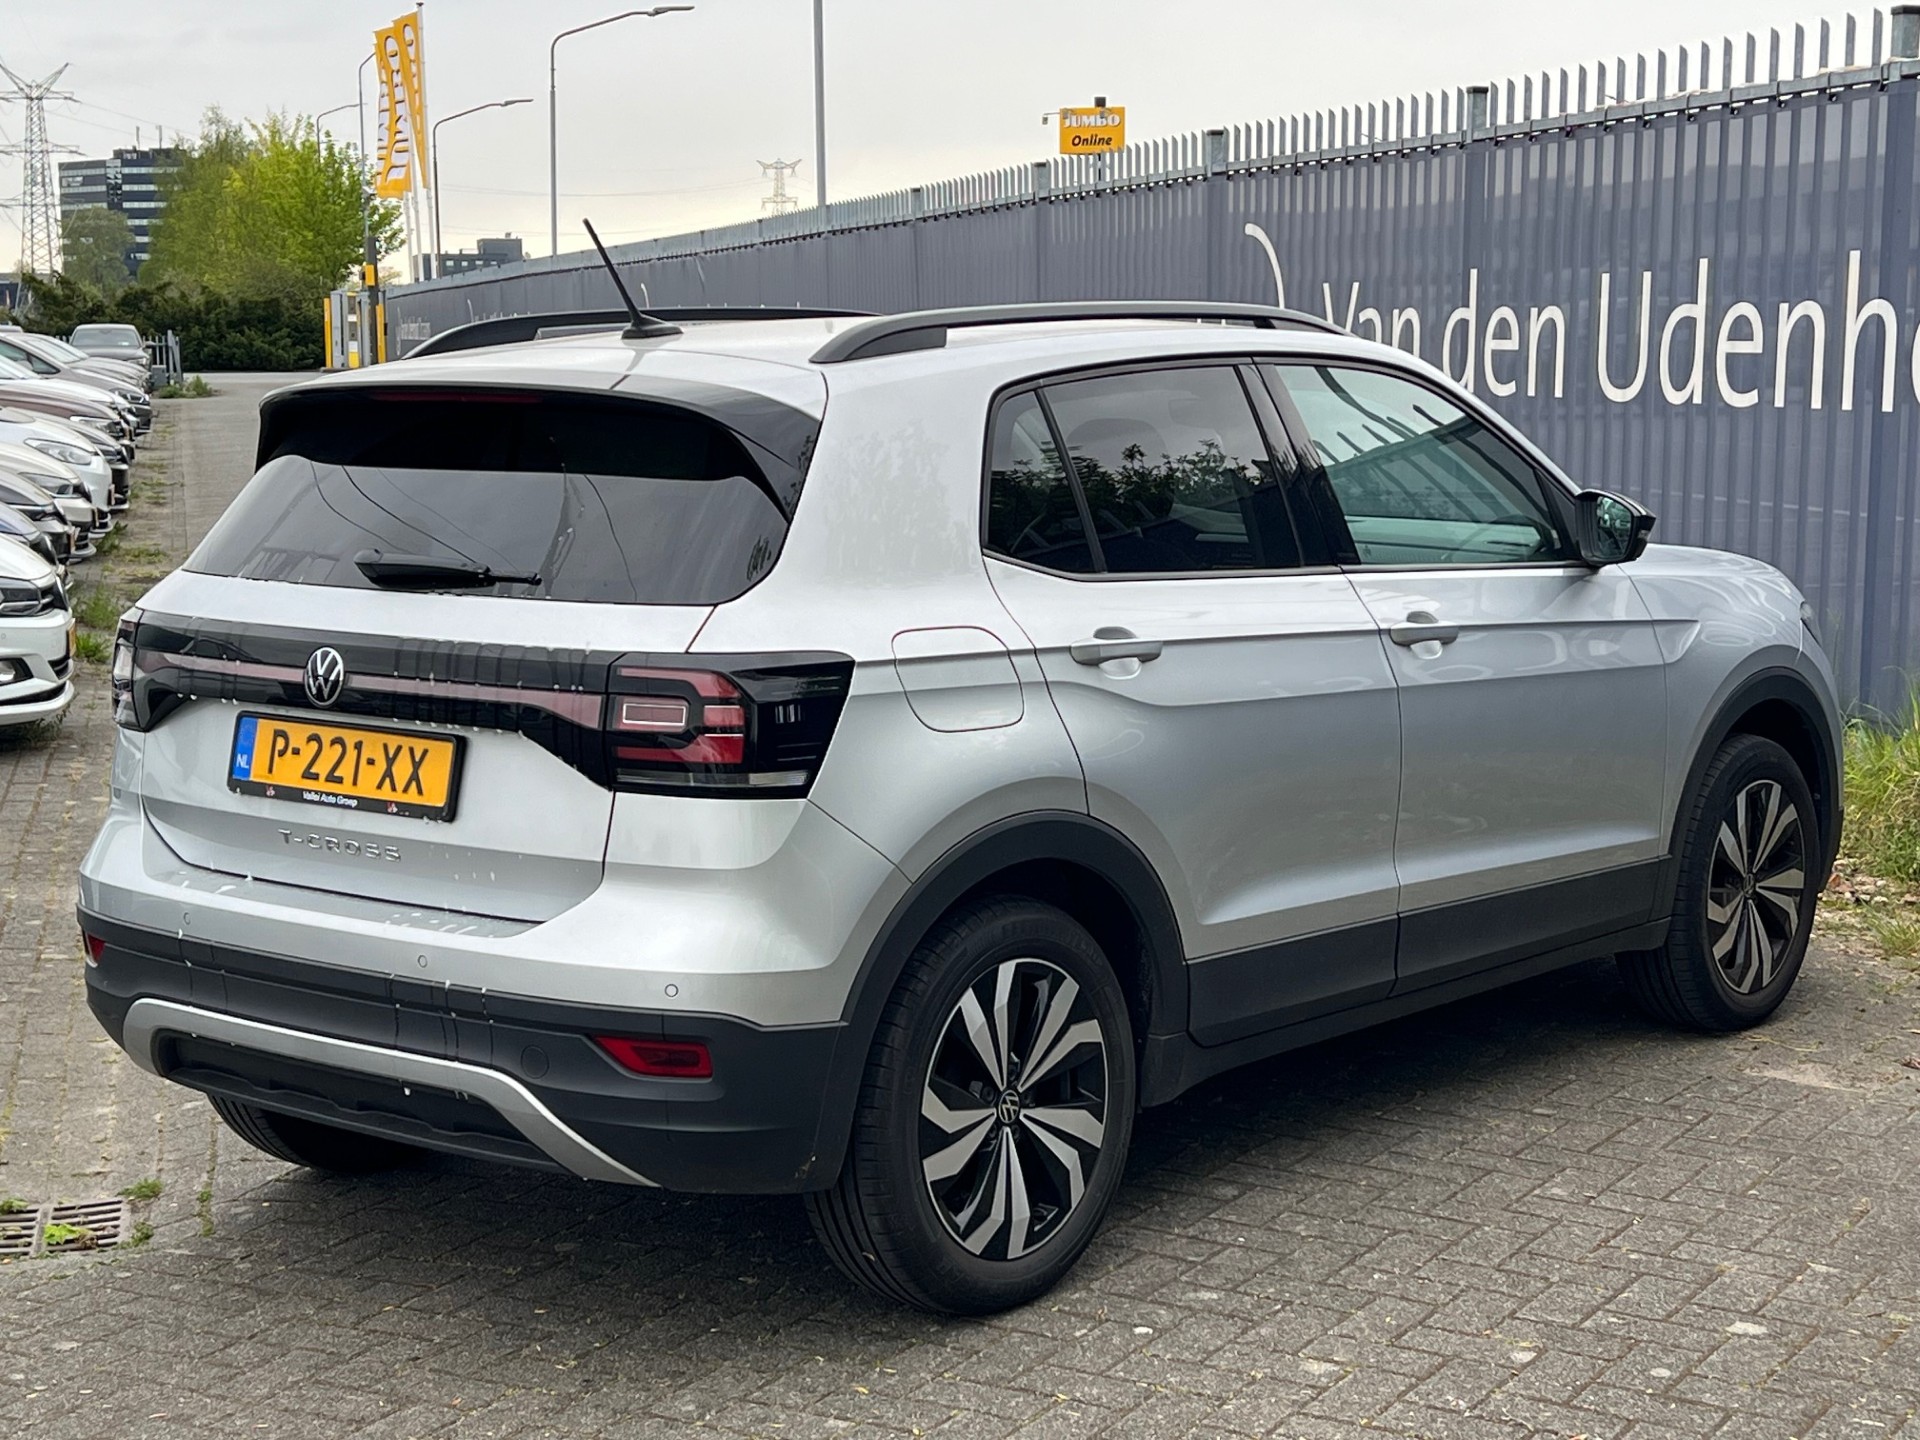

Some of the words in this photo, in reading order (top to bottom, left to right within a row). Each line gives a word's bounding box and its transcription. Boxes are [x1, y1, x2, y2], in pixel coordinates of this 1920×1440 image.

[1064, 113, 1120, 128] JUMBO
[1071, 133, 1112, 147] Online
[1442, 268, 1565, 398] den
[1598, 249, 1920, 412] Udenh
[236, 753, 250, 769] NL
[267, 729, 429, 796] P-221-XX
[278, 828, 401, 862] T-CROSS
